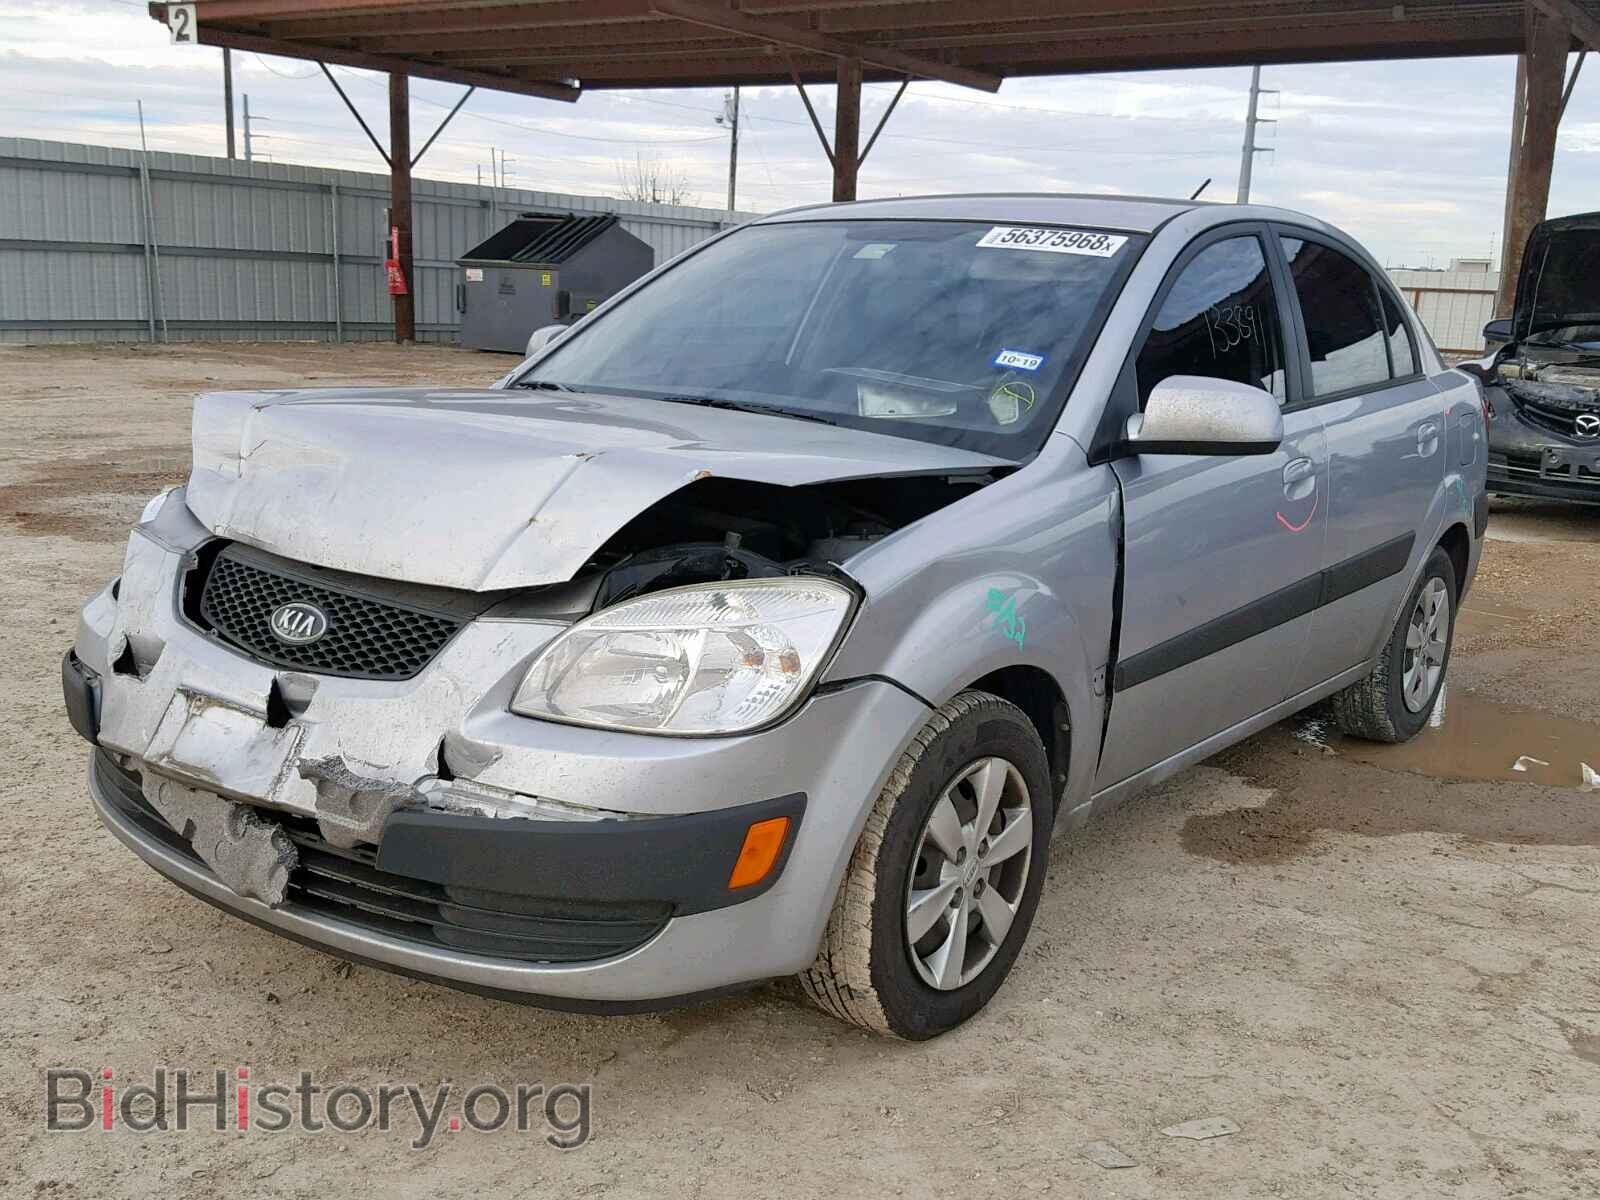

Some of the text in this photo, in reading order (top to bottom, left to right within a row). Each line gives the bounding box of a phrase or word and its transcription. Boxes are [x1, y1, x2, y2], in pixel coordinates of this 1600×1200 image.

[174, 8, 190, 42] 2
[1001, 355, 1038, 368] 10-19
[278, 609, 316, 636] KIA
